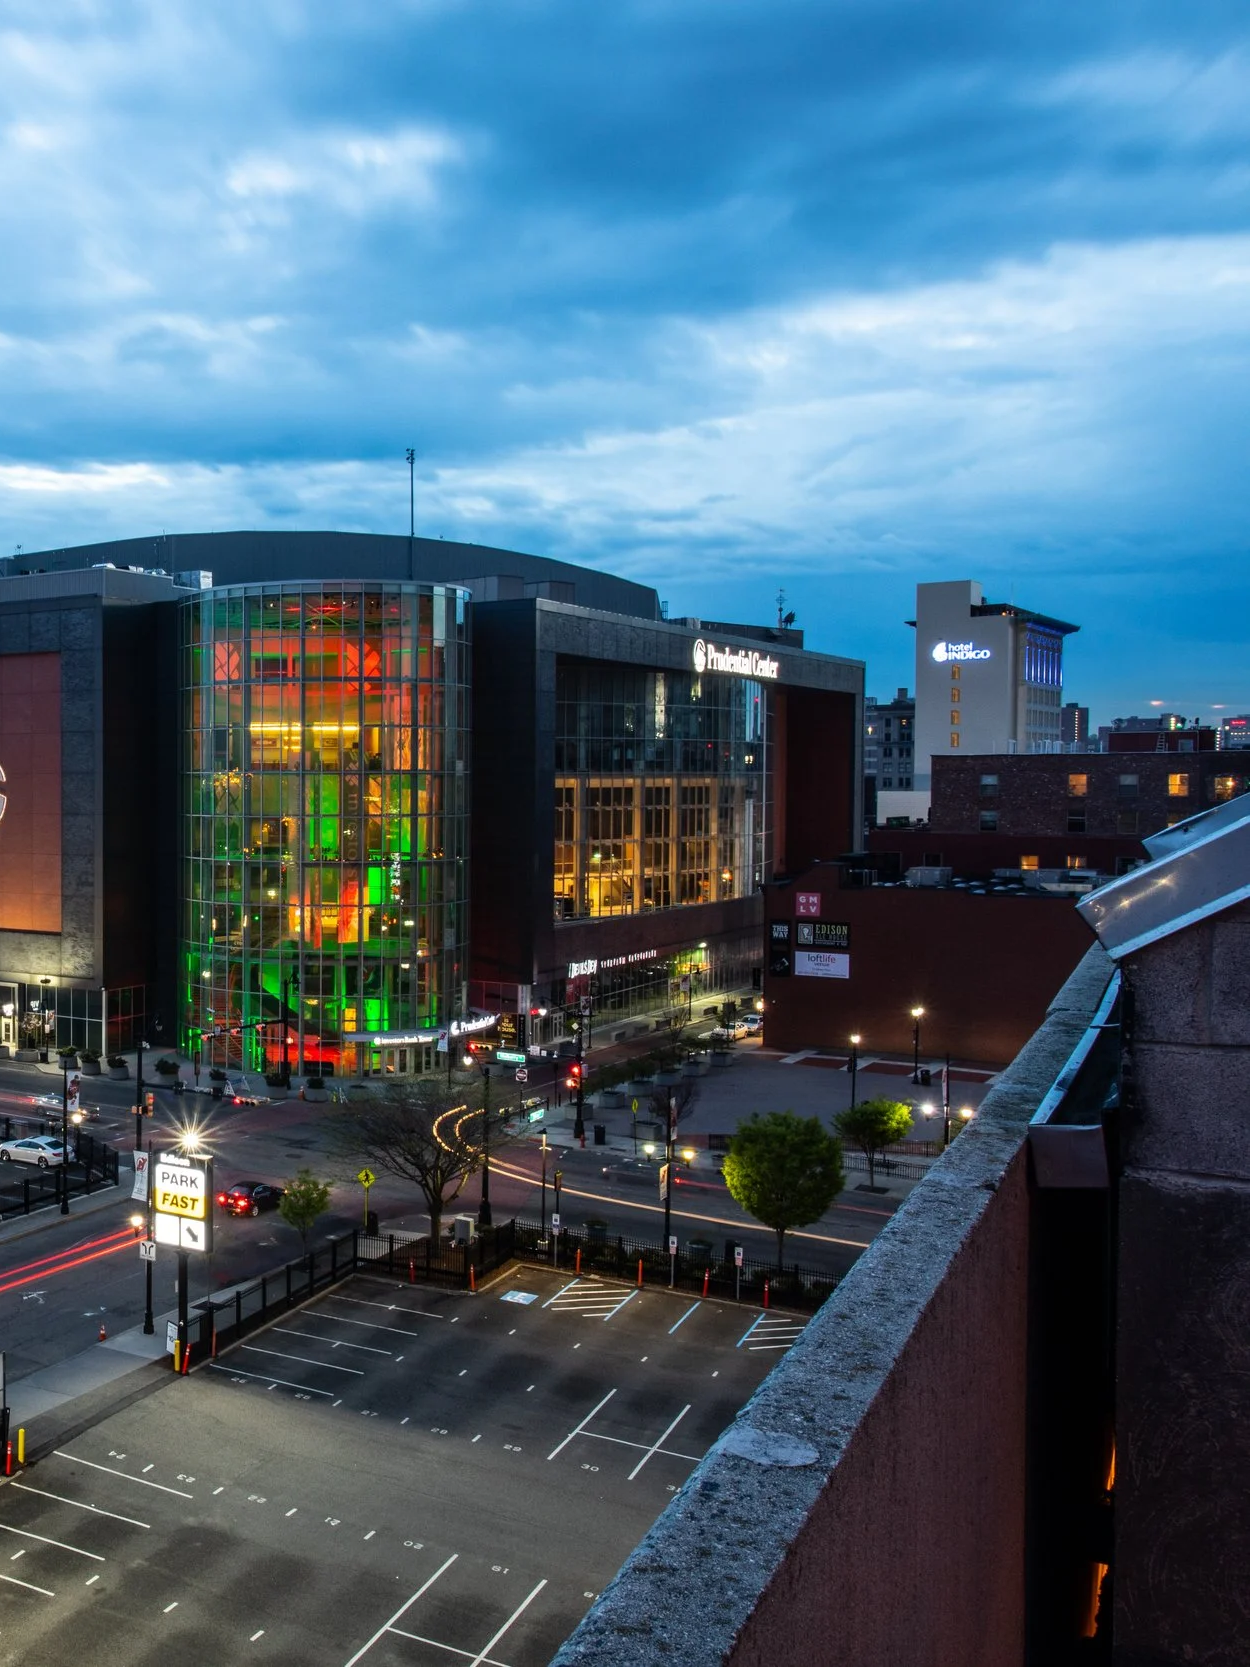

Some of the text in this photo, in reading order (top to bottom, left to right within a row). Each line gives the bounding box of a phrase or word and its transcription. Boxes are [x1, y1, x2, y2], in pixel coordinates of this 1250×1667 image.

[948, 641, 973, 652] hotel
[948, 650, 991, 660] INDIGO
[706, 644, 779, 678] Prudential Center
[815, 924, 848, 935] EDISON
[807, 953, 836, 963] loftlife
[161, 1171, 199, 1189] PARK
[161, 1193, 199, 1211] FAST
[580, 1463, 600, 1472] 30
[403, 1540, 424, 1550] 20
[491, 1564, 509, 1575] 19
